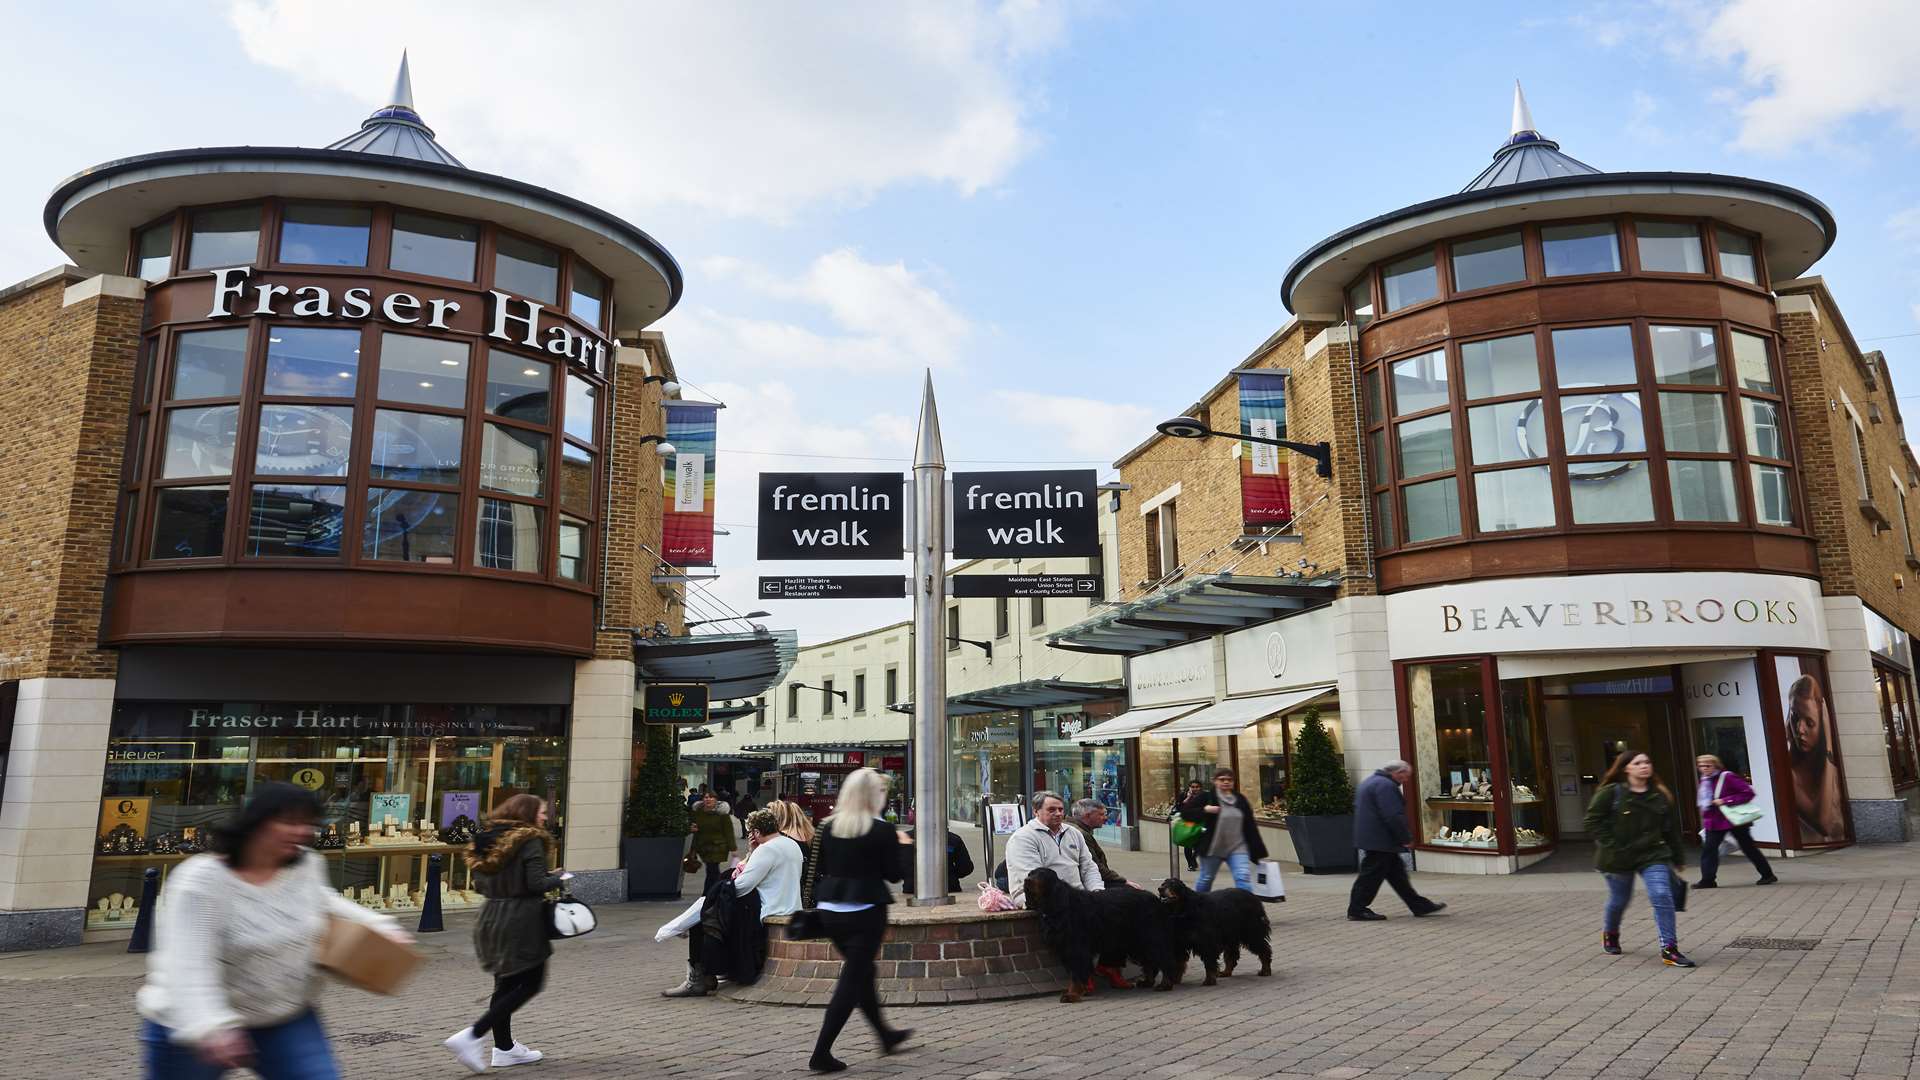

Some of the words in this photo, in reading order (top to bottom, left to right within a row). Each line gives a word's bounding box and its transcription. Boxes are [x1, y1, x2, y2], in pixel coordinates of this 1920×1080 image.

[206, 265, 461, 330] Fraser
[487, 289, 606, 374] Hart
[772, 485, 890, 511] fremlin
[966, 483, 1084, 510] fremlin
[792, 520, 870, 546] walk
[987, 518, 1065, 545] walk
[1440, 598, 1799, 634] BEAVERBROOKS
[188, 708, 283, 728] Fraser
[294, 709, 363, 729] Hart
[440, 721, 475, 729] SINCE
[648, 708, 703, 718] ROLEX
